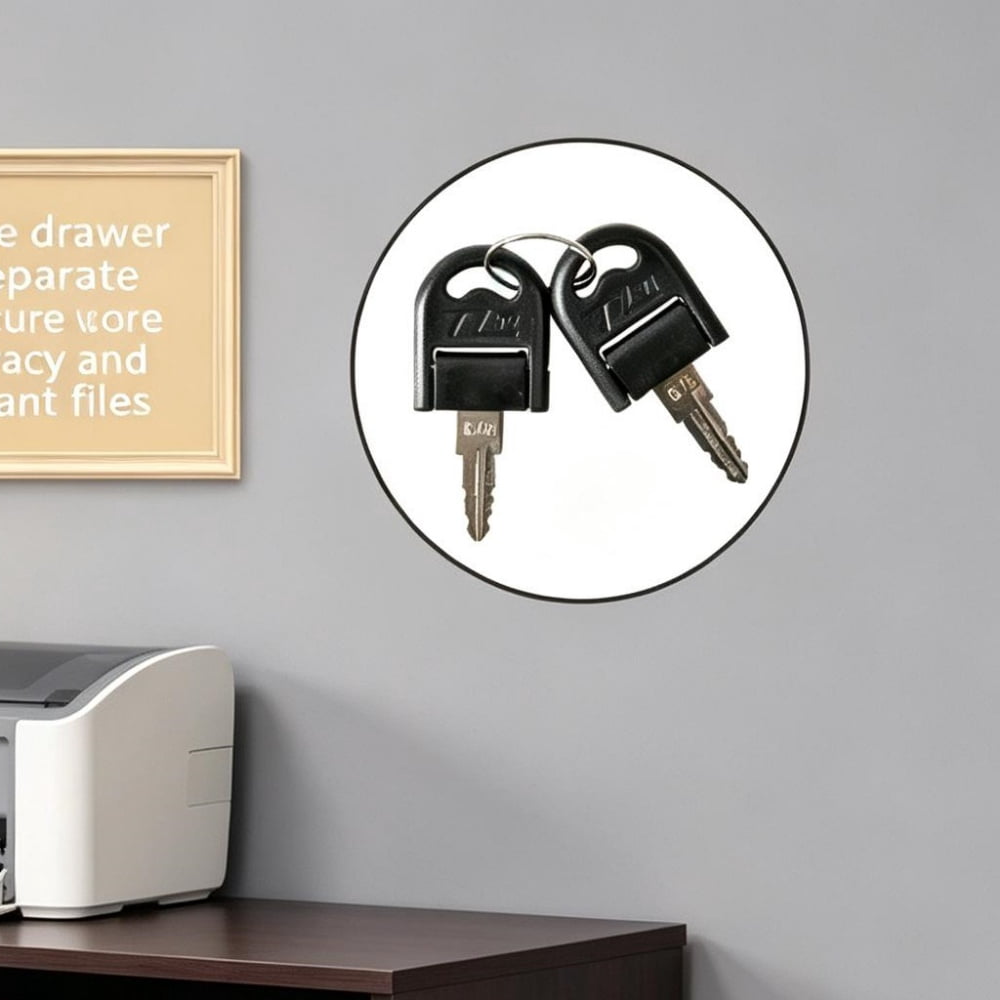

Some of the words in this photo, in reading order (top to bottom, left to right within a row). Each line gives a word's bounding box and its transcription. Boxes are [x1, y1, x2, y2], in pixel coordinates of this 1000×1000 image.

[30, 214, 170, 248] drawer
[78, 343, 147, 375] and
[71, 383, 151, 417] files
